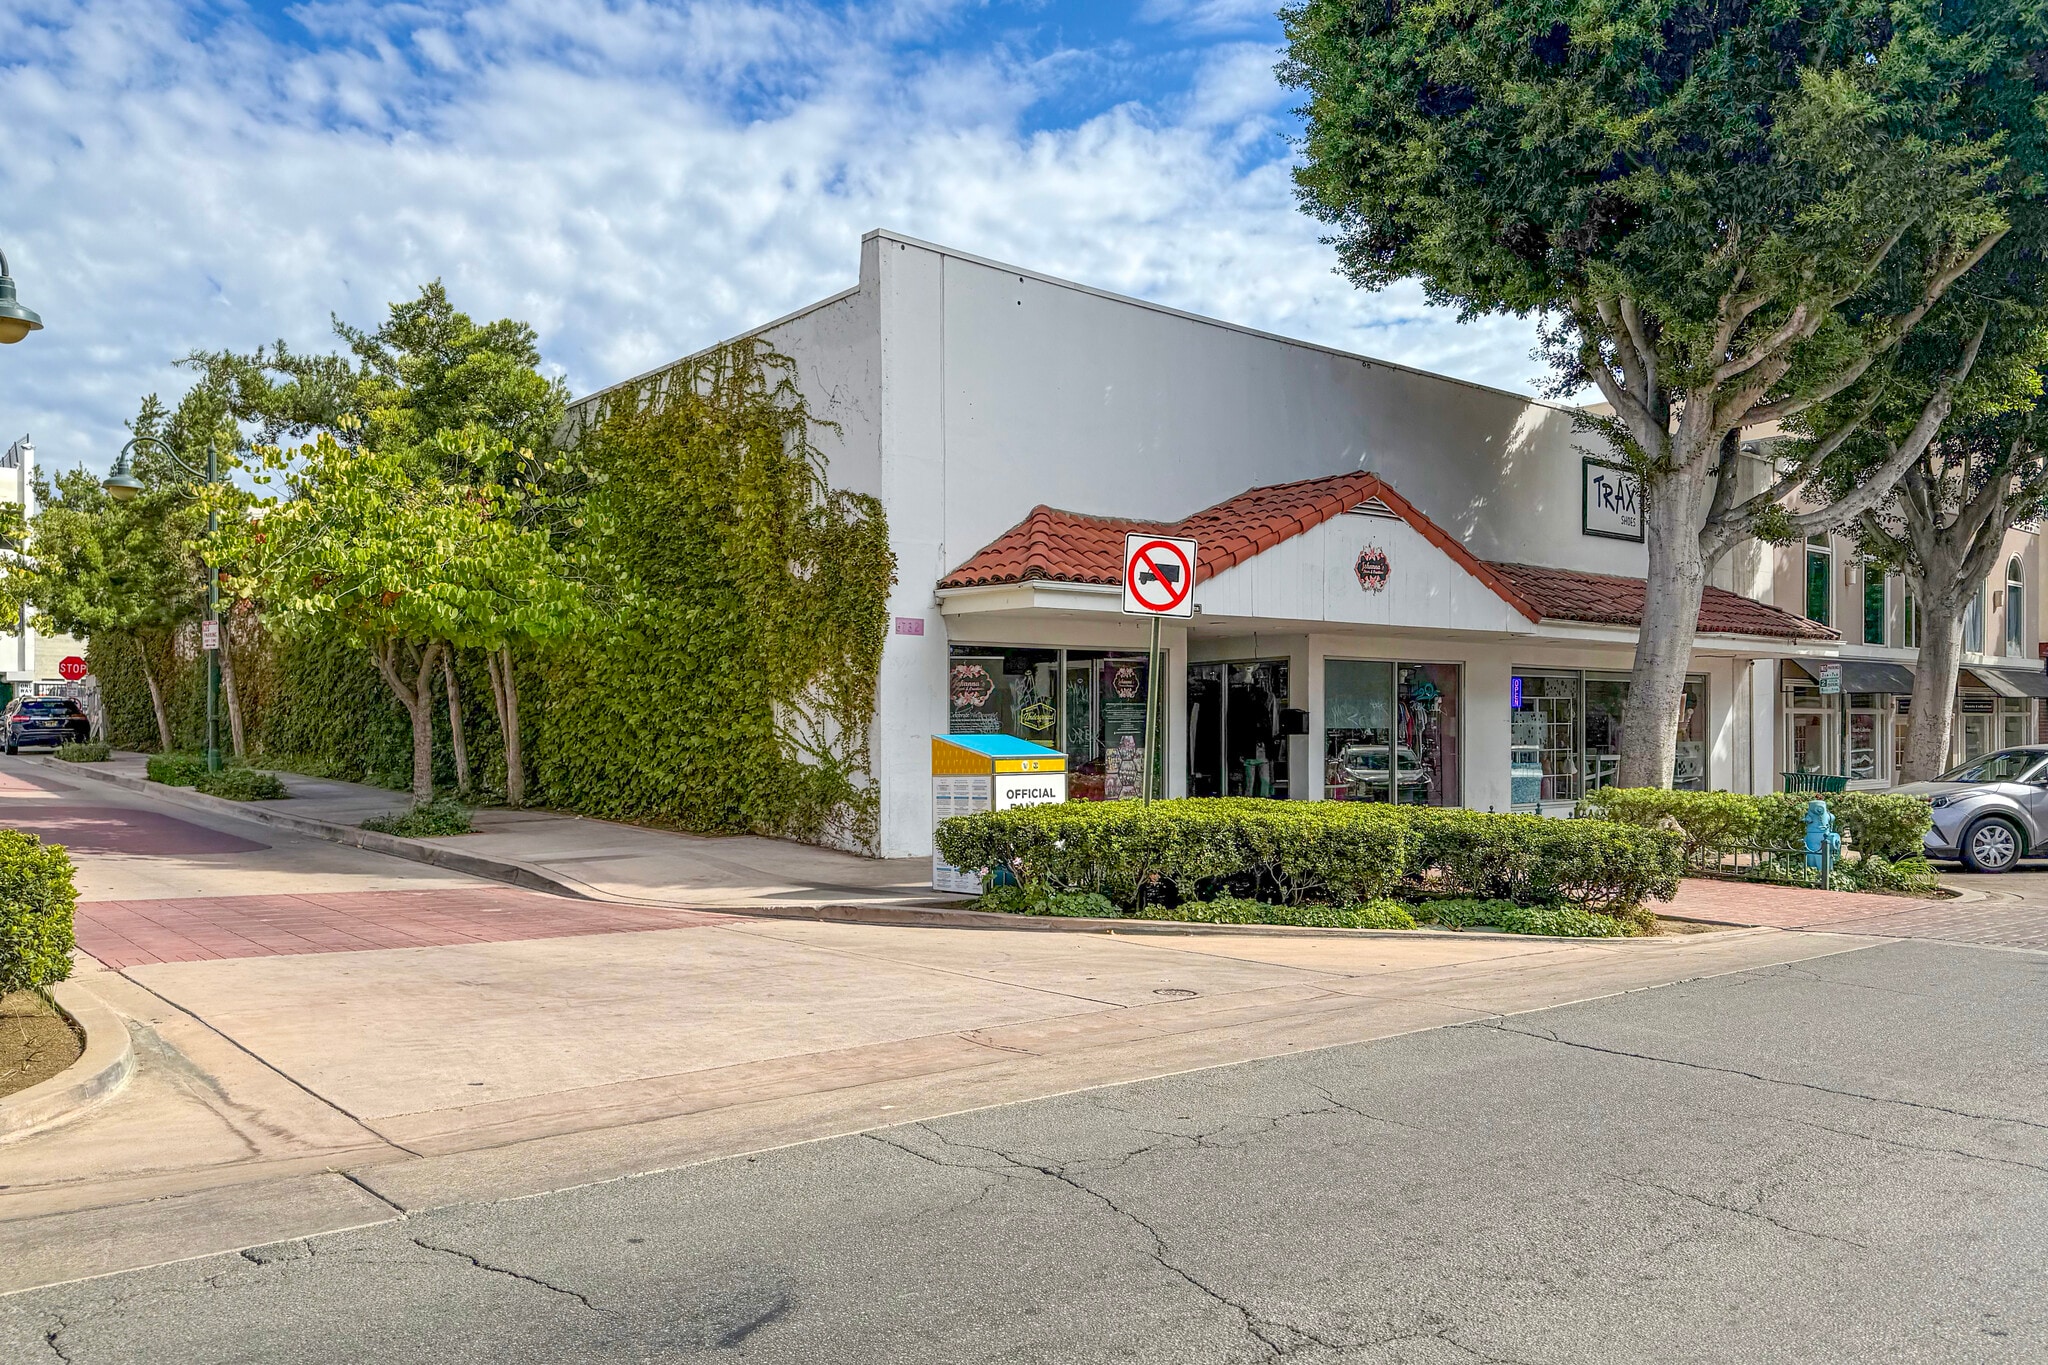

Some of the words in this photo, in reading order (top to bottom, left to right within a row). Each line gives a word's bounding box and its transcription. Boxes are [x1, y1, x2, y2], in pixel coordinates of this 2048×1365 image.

[1593, 475, 1636, 515] TRAX
[1621, 515, 1636, 527] SHOES
[60, 663, 87, 674] STOP
[1006, 787, 1056, 800] OFFICIAL
